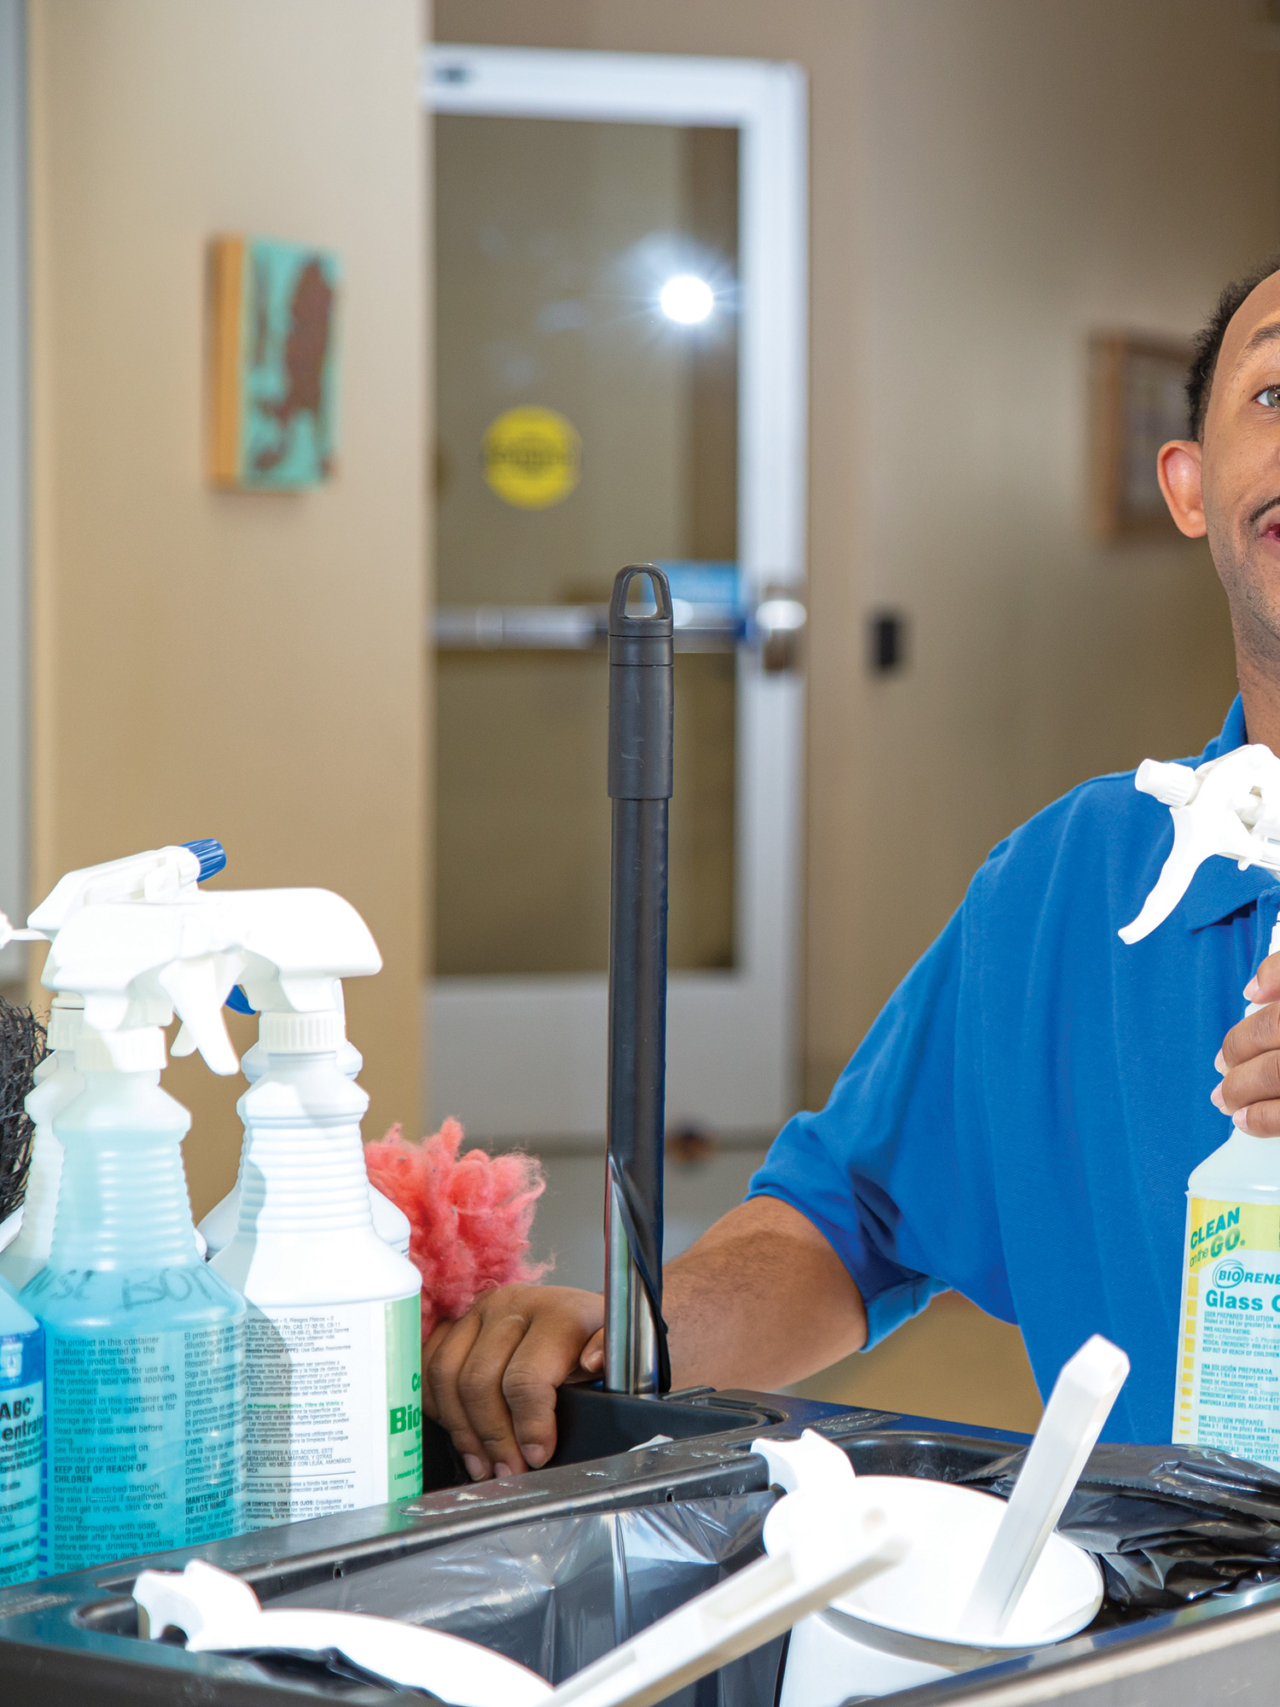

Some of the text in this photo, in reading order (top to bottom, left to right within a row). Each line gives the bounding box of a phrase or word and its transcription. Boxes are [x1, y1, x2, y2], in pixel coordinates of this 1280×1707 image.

[1190, 1206, 1240, 1250] CLEAN
[1206, 1290, 1263, 1311] Glass
[54, 1338, 66, 1346] The
[68, 1339, 96, 1347] product
[108, 1338, 122, 1346] this
[124, 1337, 159, 1346] container
[61, 1348, 85, 1356] diluted
[98, 1347, 128, 1356] directed
[143, 1346, 155, 1354] the
[54, 1358, 84, 1367] pesticide
[87, 1358, 116, 1366] product
[54, 1368, 76, 1376] Follow
[91, 1367, 129, 1375] directions
[54, 1374, 174, 1387] the pesticide label when applying
[54, 1387, 66, 1395] this
[54, 1397, 66, 1405] The
[68, 1397, 96, 1406] product
[108, 1397, 122, 1405] this
[124, 1395, 159, 1405] container
[162, 1393, 177, 1402] with
[54, 1407, 85, 1415] pesticide
[96, 1407, 108, 1415] not
[110, 1406, 121, 1414] for
[123, 1405, 138, 1413] sale
[141, 1404, 155, 1413] and
[54, 1417, 80, 1425] storage
[81, 1417, 96, 1425] and
[54, 1427, 71, 1435] Read
[74, 1427, 96, 1436] safety
[97, 1427, 114, 1435] data
[116, 1426, 137, 1434] sheet
[98, 1445, 136, 1453] statement
[87, 1455, 117, 1464] product
[54, 1463, 147, 1474] KEEP OUT OF REACH OF
[54, 1475, 92, 1483] CHILDREN
[91, 1485, 127, 1493] absorbed
[129, 1483, 159, 1492] through
[54, 1505, 63, 1513] Do
[65, 1505, 77, 1513] not
[79, 1505, 91, 1514] get
[124, 1502, 140, 1510] skin
[54, 1524, 73, 1532] Wash
[76, 1524, 117, 1533] thoroughly
[137, 1522, 155, 1531] soap
[91, 1533, 109, 1541] after
[111, 1531, 143, 1541] handling
[54, 1543, 76, 1551] before
[142, 1539, 173, 1548] smoking
[86, 1552, 117, 1560] chewing
